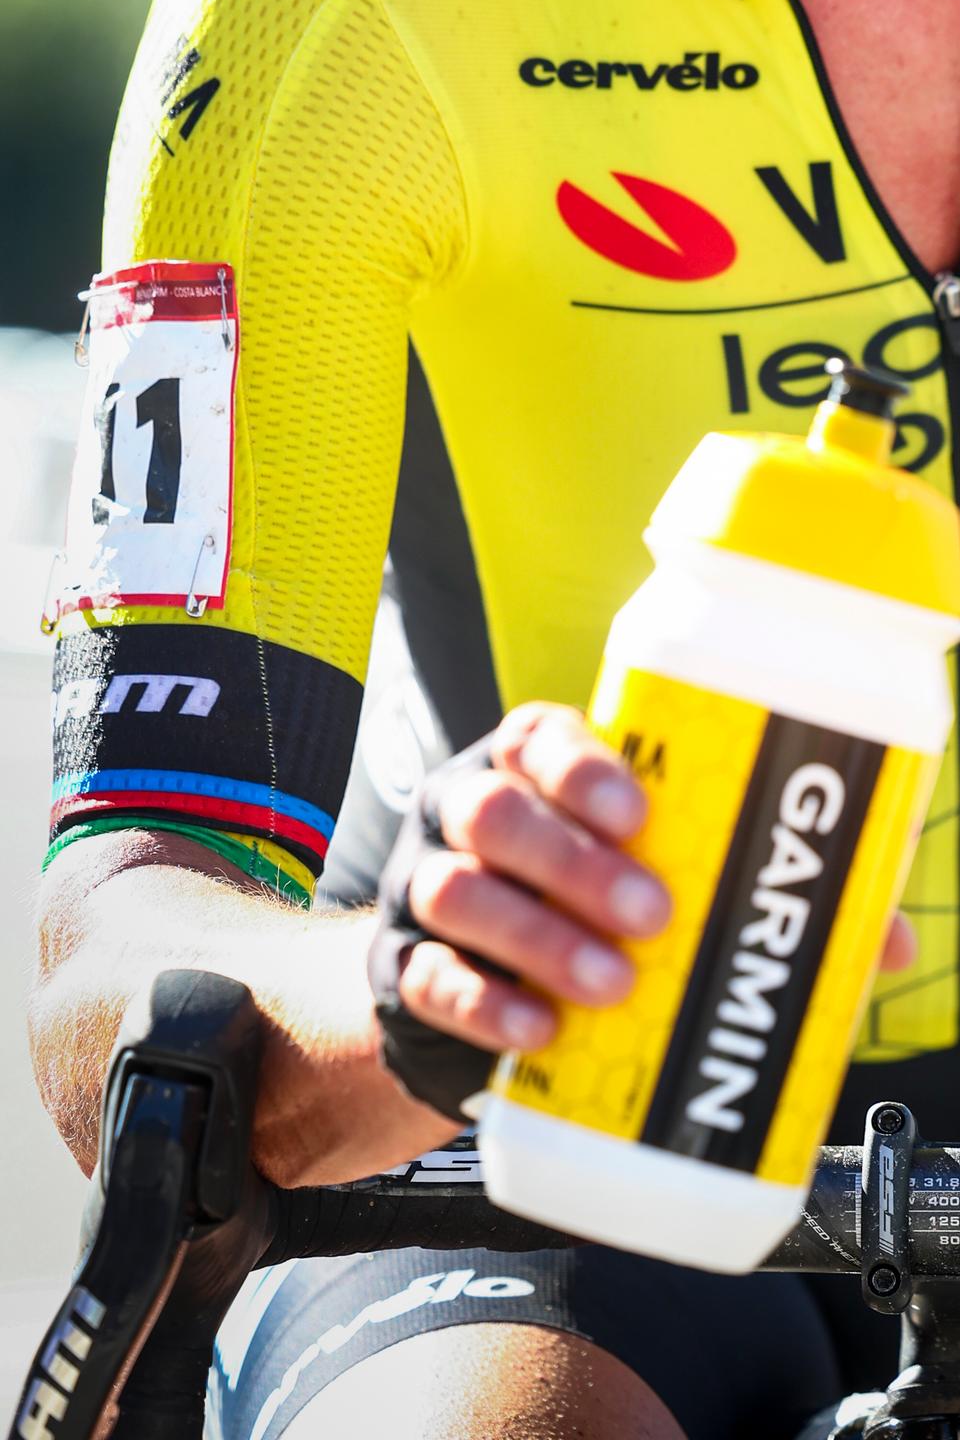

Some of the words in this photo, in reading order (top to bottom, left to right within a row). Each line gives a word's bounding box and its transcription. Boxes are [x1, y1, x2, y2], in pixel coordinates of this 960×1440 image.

[518, 51, 760, 92] cervélo
[174, 286, 195, 298] COSTA
[686, 762, 848, 1133] GARMIN
